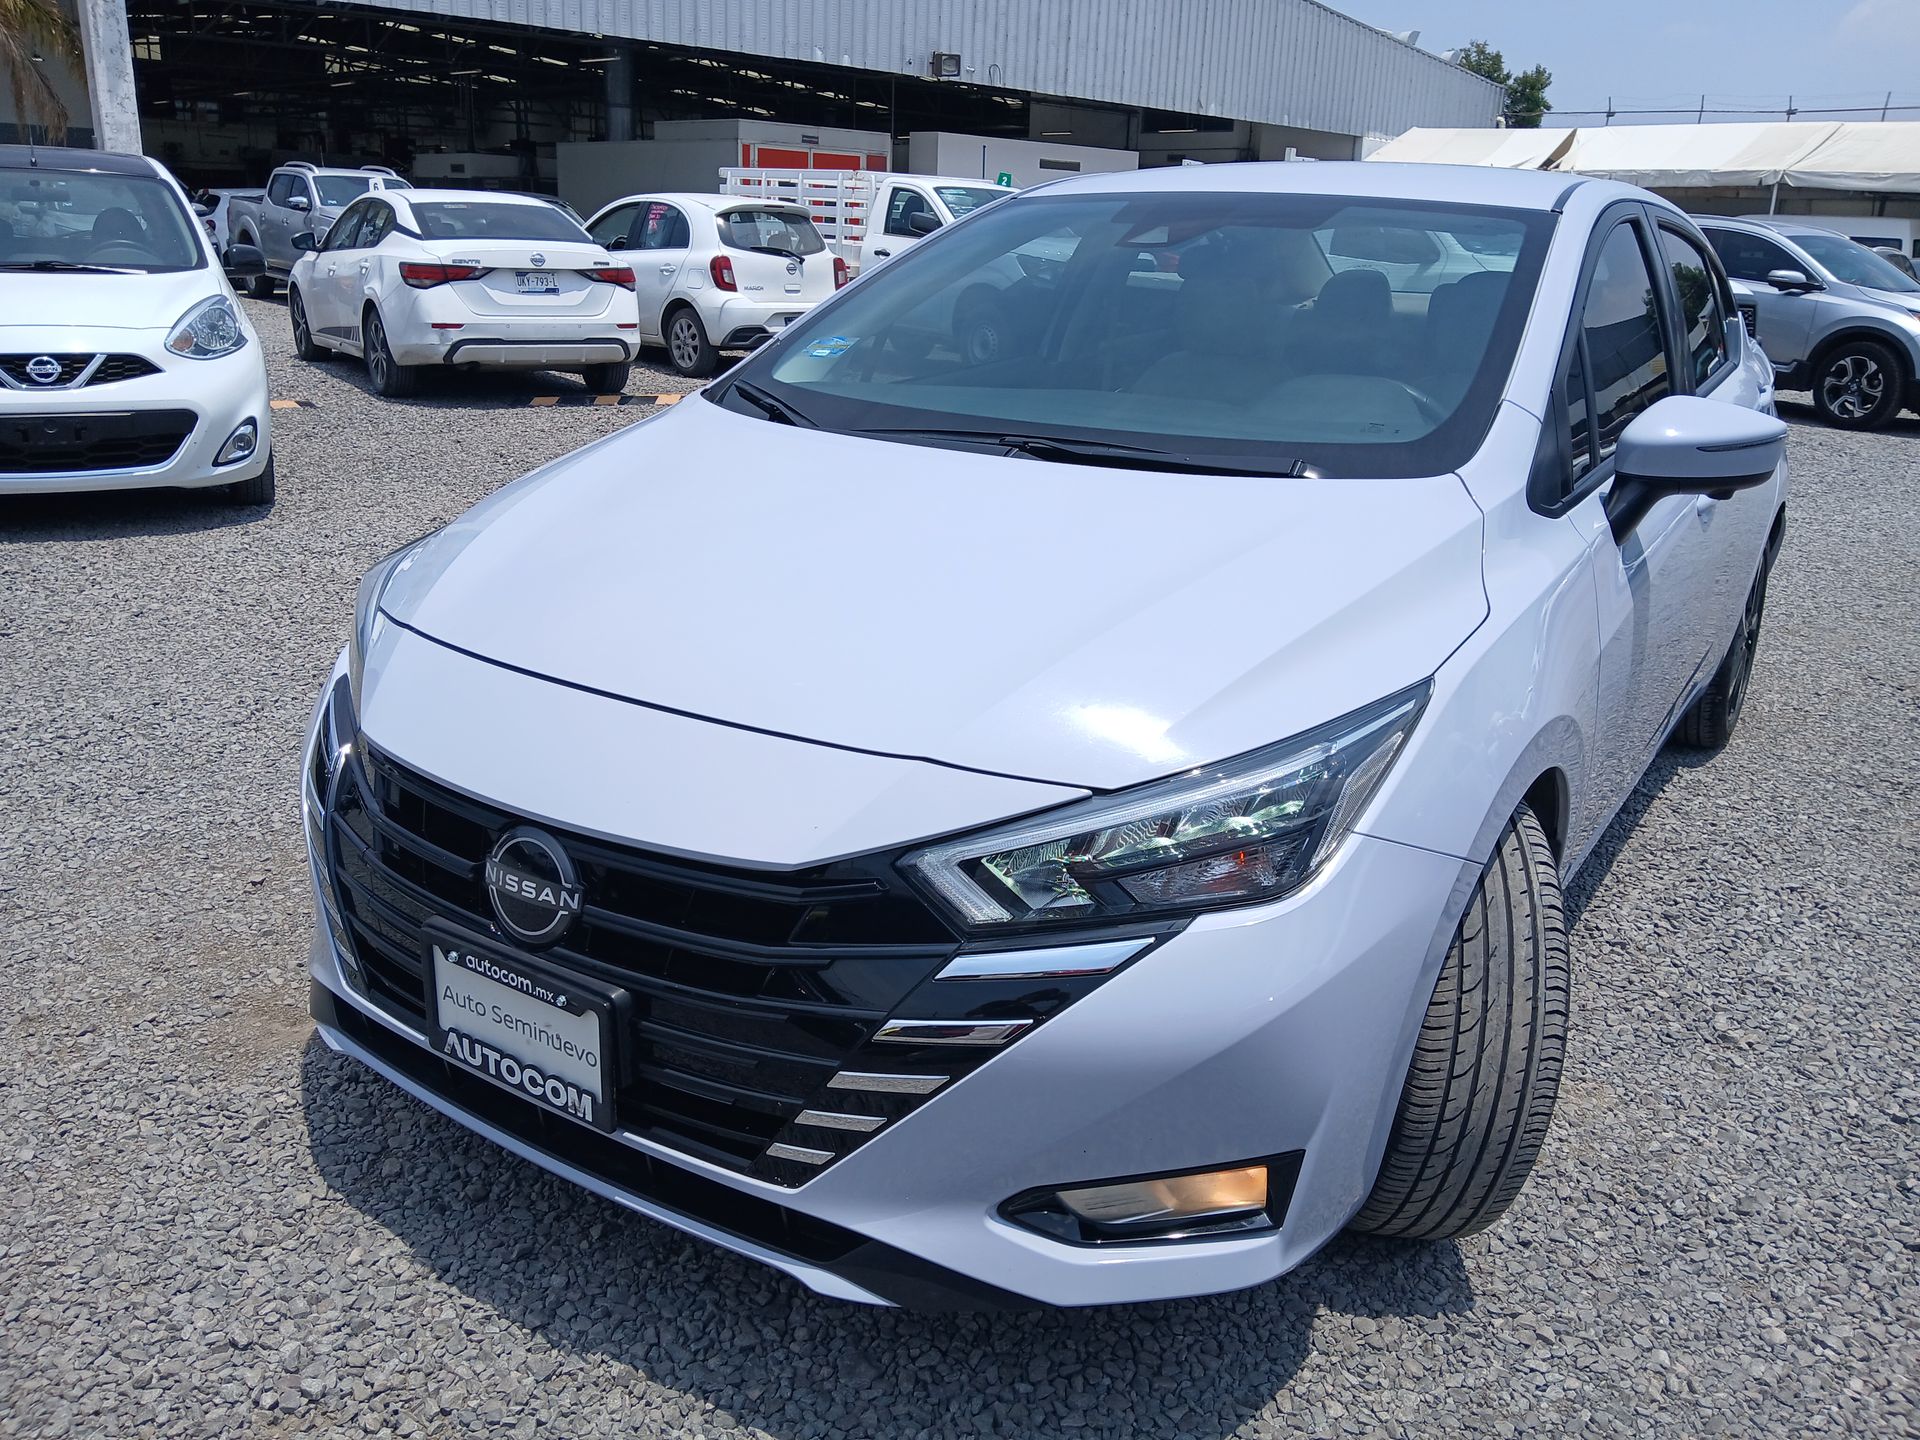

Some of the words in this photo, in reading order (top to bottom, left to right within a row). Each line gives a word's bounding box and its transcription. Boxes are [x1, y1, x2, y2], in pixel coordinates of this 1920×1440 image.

[1002, 176, 1008, 186] 2
[515, 276, 559, 287] UKY-793-L
[486, 862, 580, 910] NISSAN
[465, 954, 555, 1003] autocom.mx
[443, 985, 487, 1017] Auto
[491, 1005, 598, 1068] Seminuevo
[444, 1031, 593, 1123] AUTOCOM
